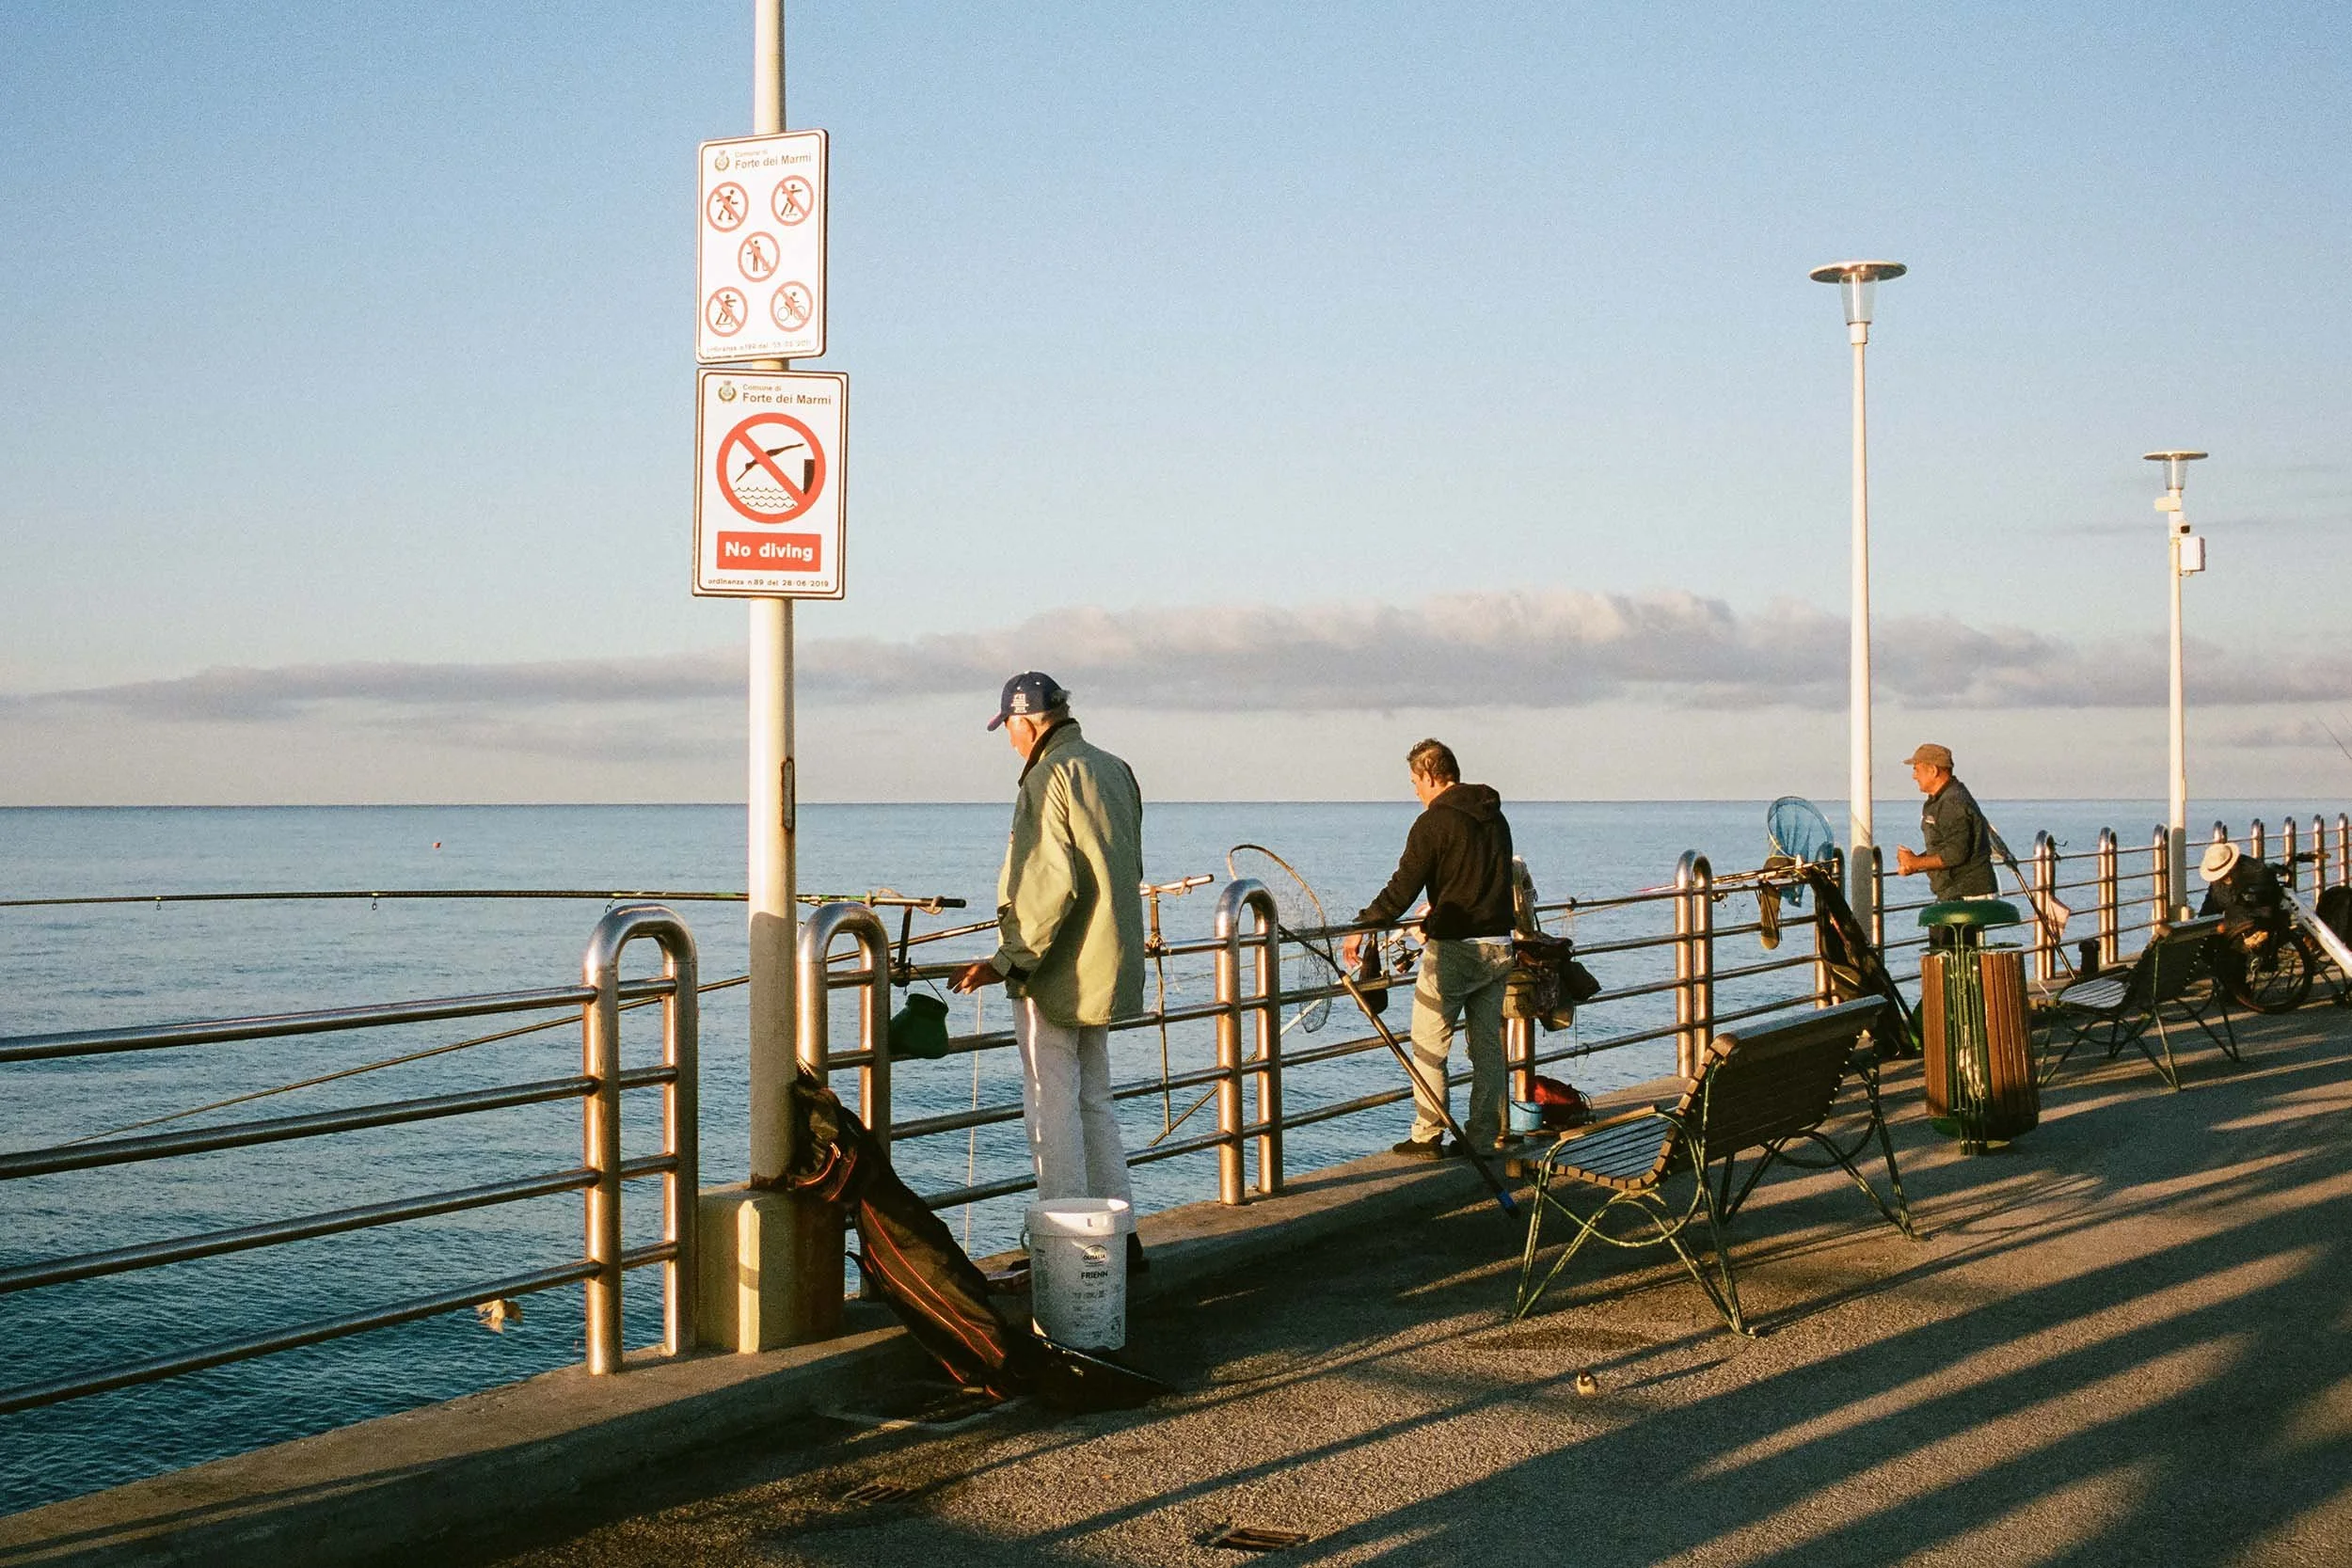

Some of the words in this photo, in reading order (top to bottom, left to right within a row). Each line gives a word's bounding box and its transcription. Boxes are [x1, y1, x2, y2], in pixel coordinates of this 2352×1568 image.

[735, 159, 760, 169] Forte
[763, 156, 778, 166] dei
[781, 152, 812, 165] Marmi
[742, 392, 772, 404] Forte
[775, 393, 793, 404] dei
[796, 394, 832, 405] Marmi
[724, 541, 752, 557] No
[758, 542, 814, 562] diving
[707, 578, 744, 586] ordinanza
[1081, 1270, 1108, 1280] FRIENN
